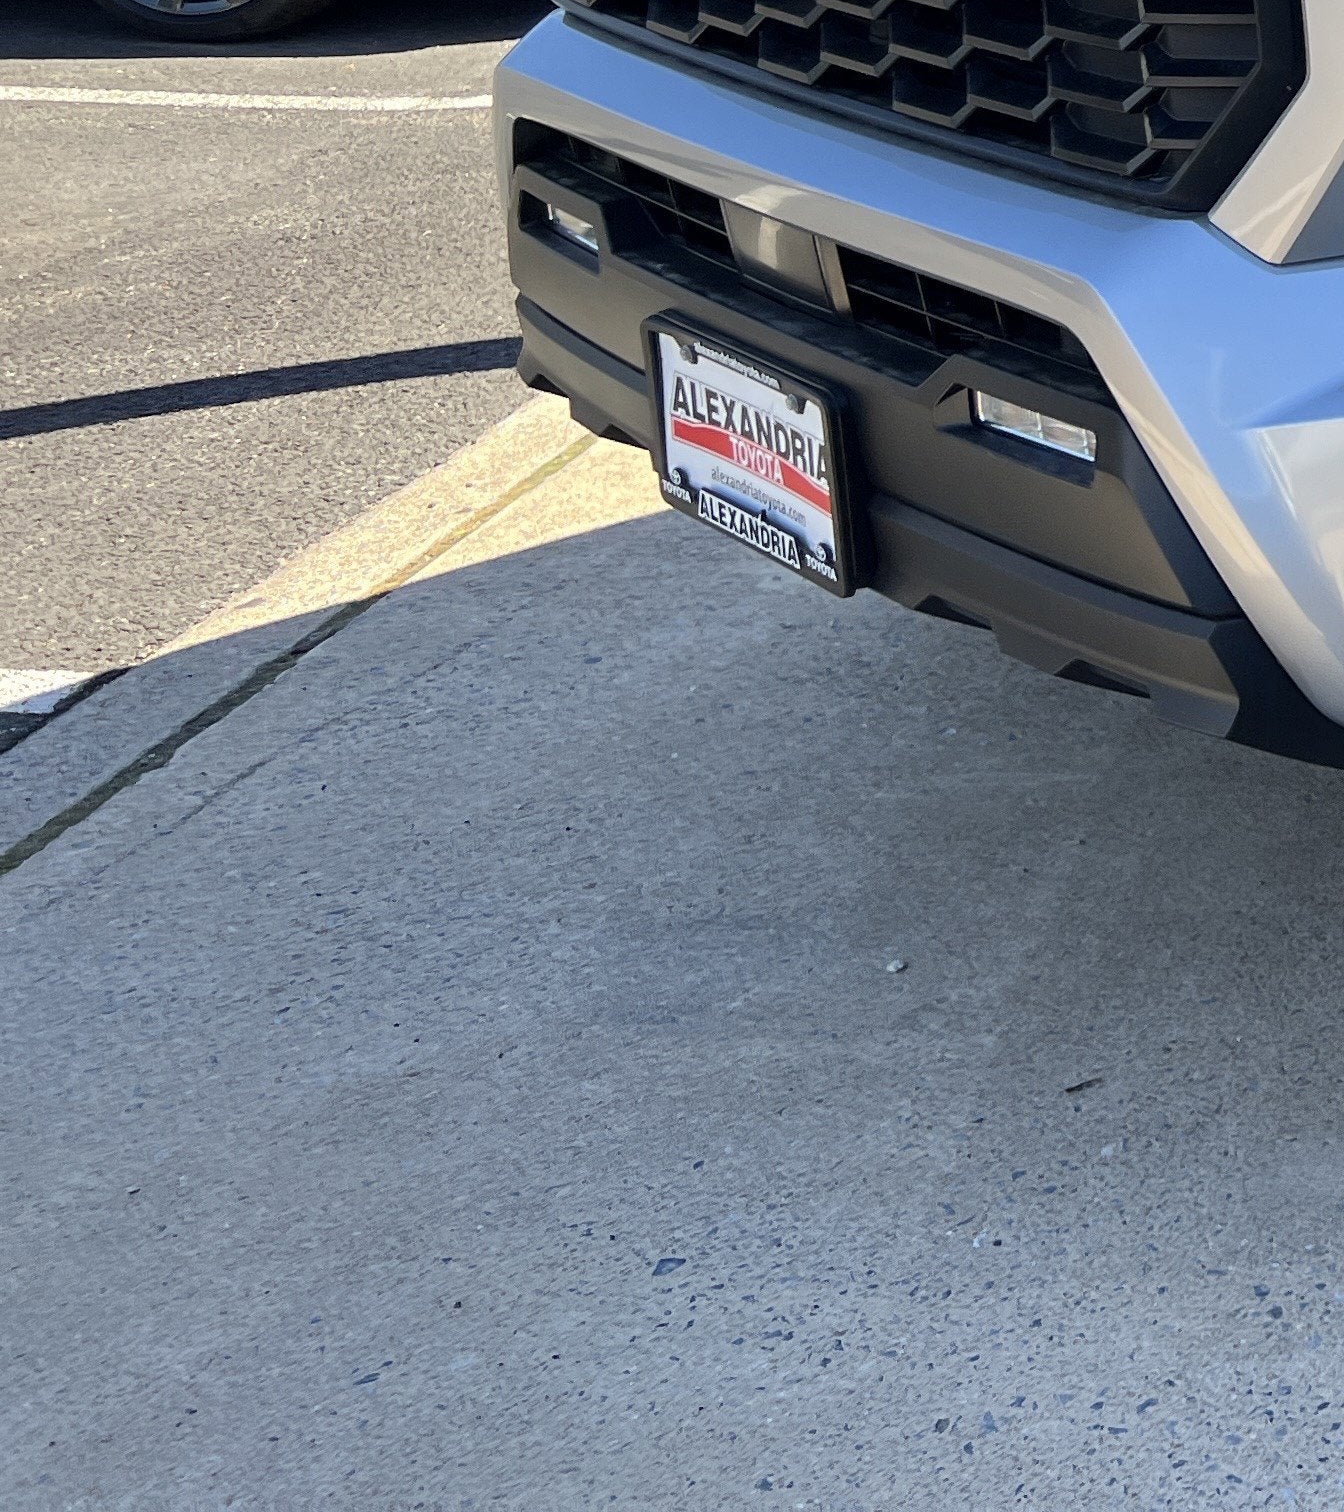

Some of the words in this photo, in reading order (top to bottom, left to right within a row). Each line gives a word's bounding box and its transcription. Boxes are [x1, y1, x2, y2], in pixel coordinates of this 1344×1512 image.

[673, 376, 827, 480] ALEXANDRIA
[729, 436, 785, 486] TOYOTA
[662, 479, 692, 504] TOYOTA
[700, 492, 799, 567] ALEXANDRIA
[805, 554, 838, 582] TOYOTA
